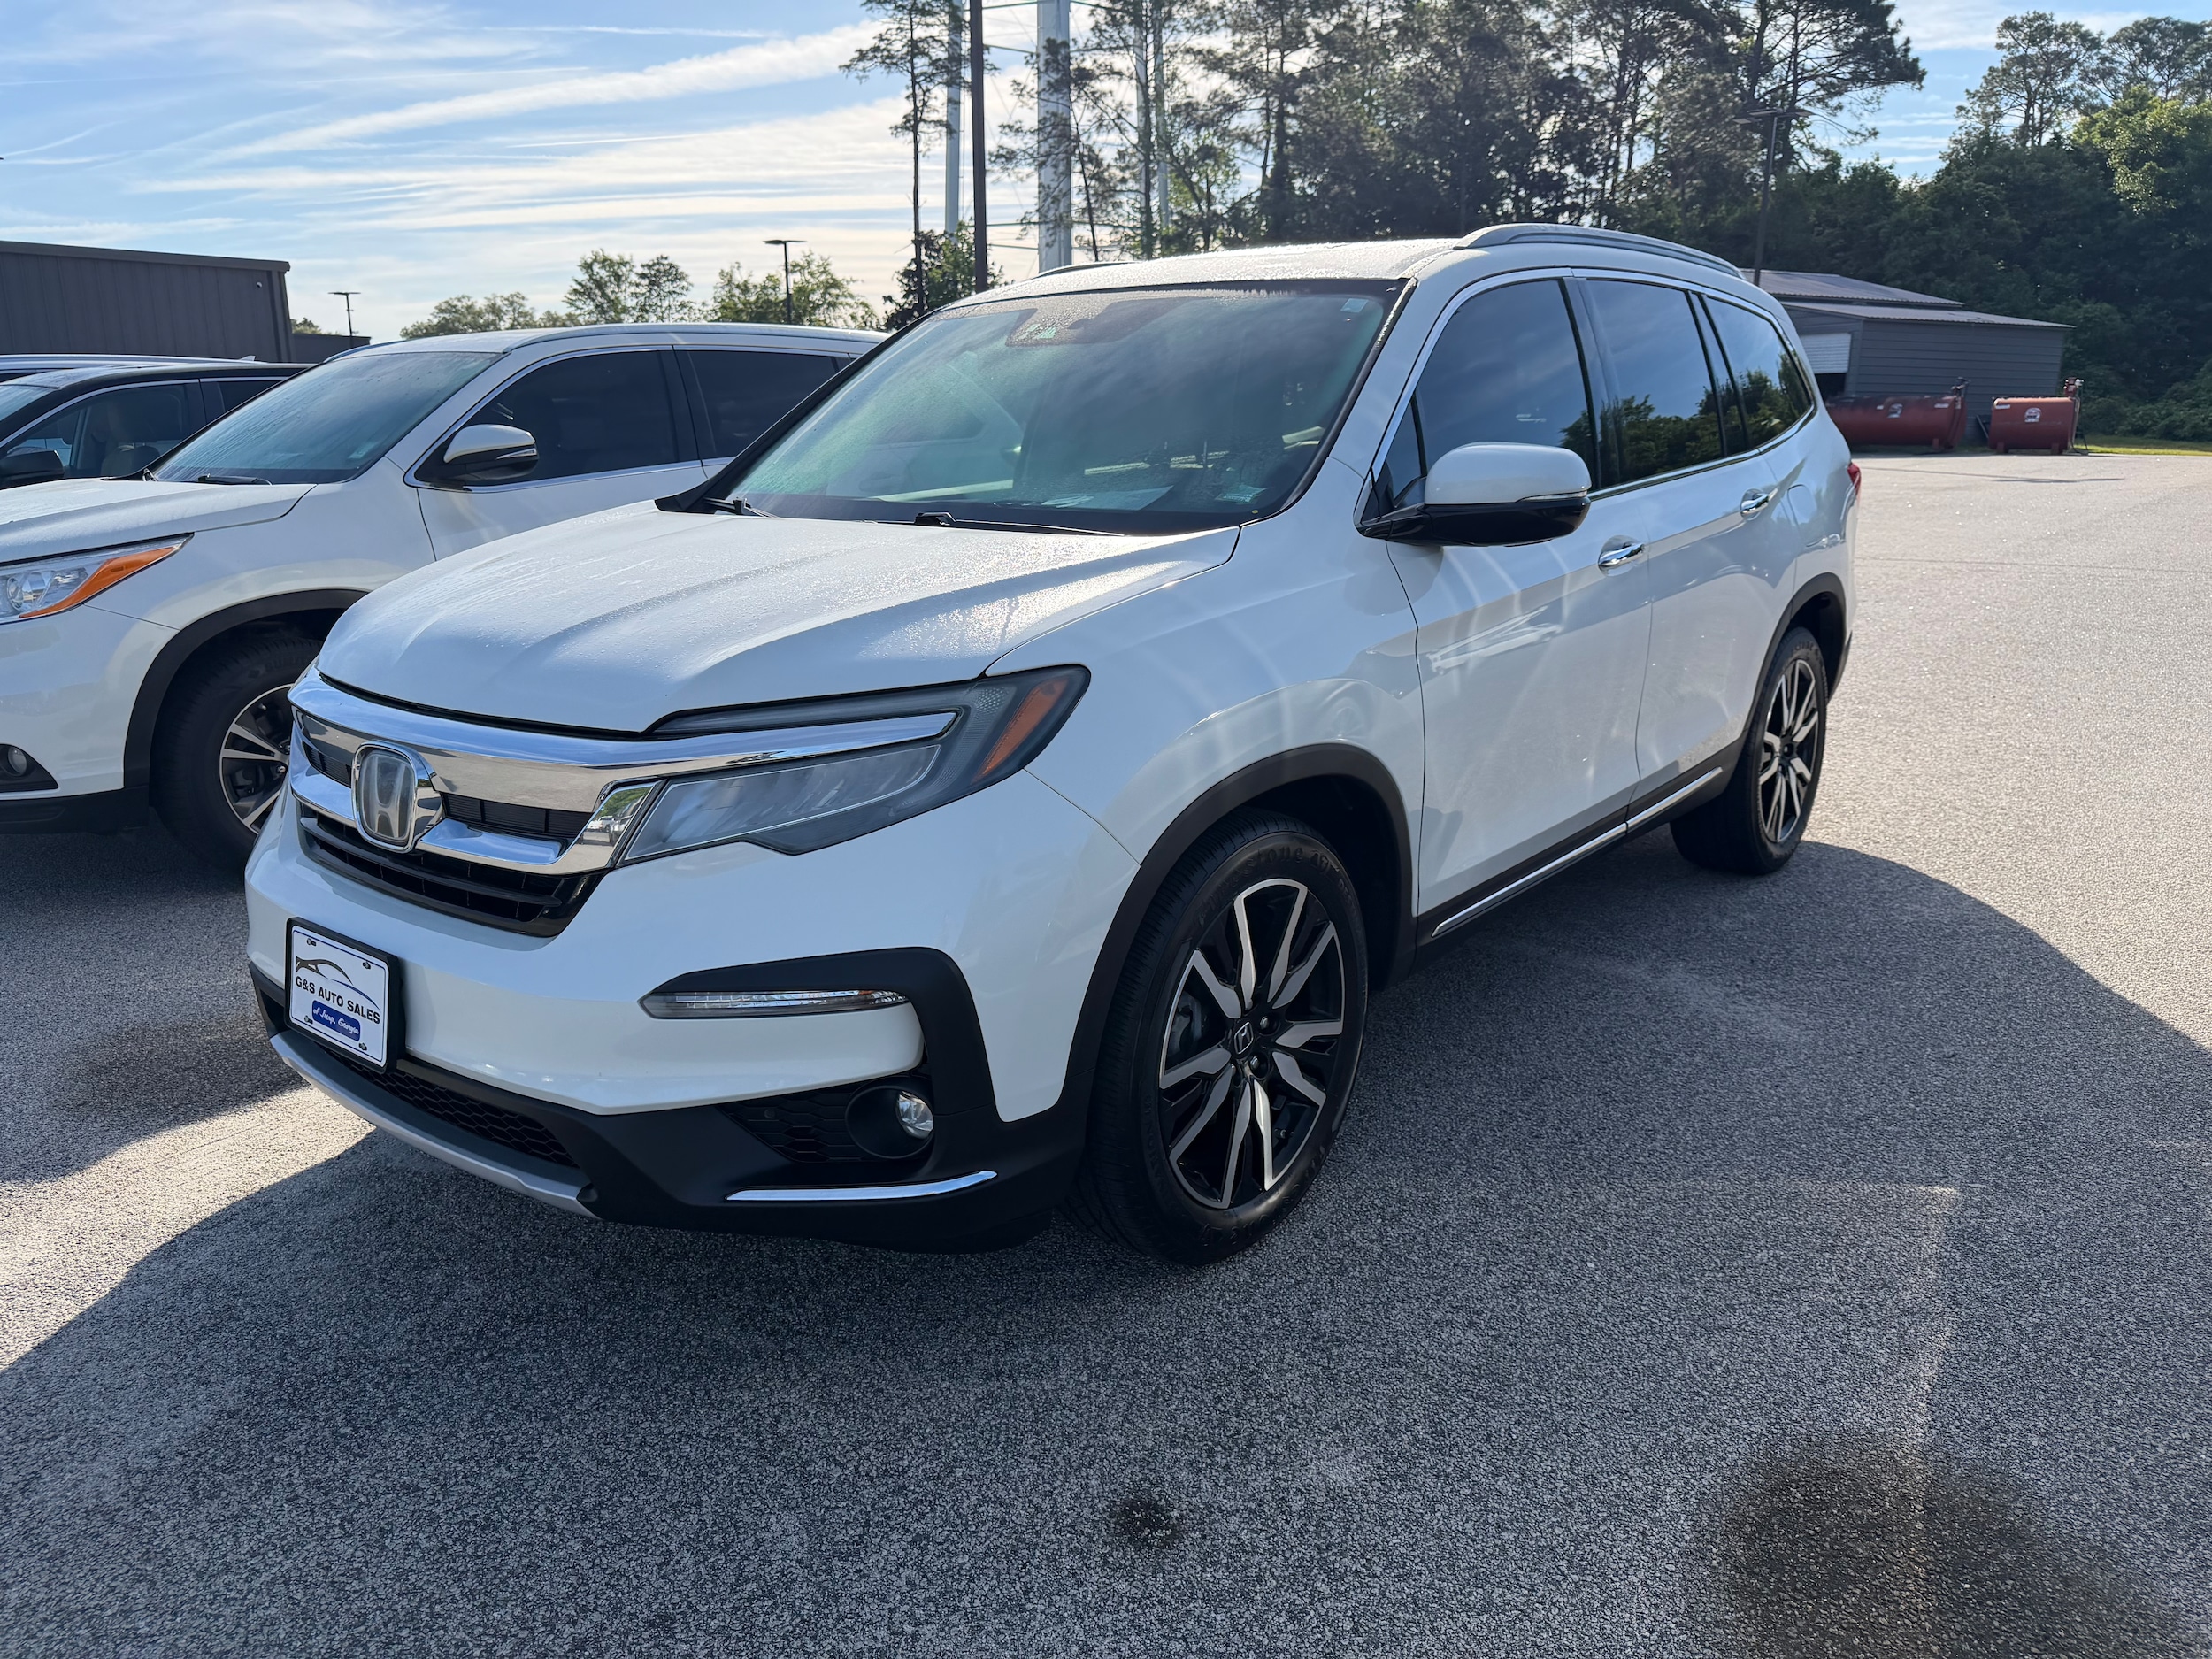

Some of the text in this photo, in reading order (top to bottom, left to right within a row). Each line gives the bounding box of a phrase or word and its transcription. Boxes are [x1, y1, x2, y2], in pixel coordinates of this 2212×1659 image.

[295, 975, 380, 1025] G&S AUTO SALES
[312, 1006, 320, 1015] of
